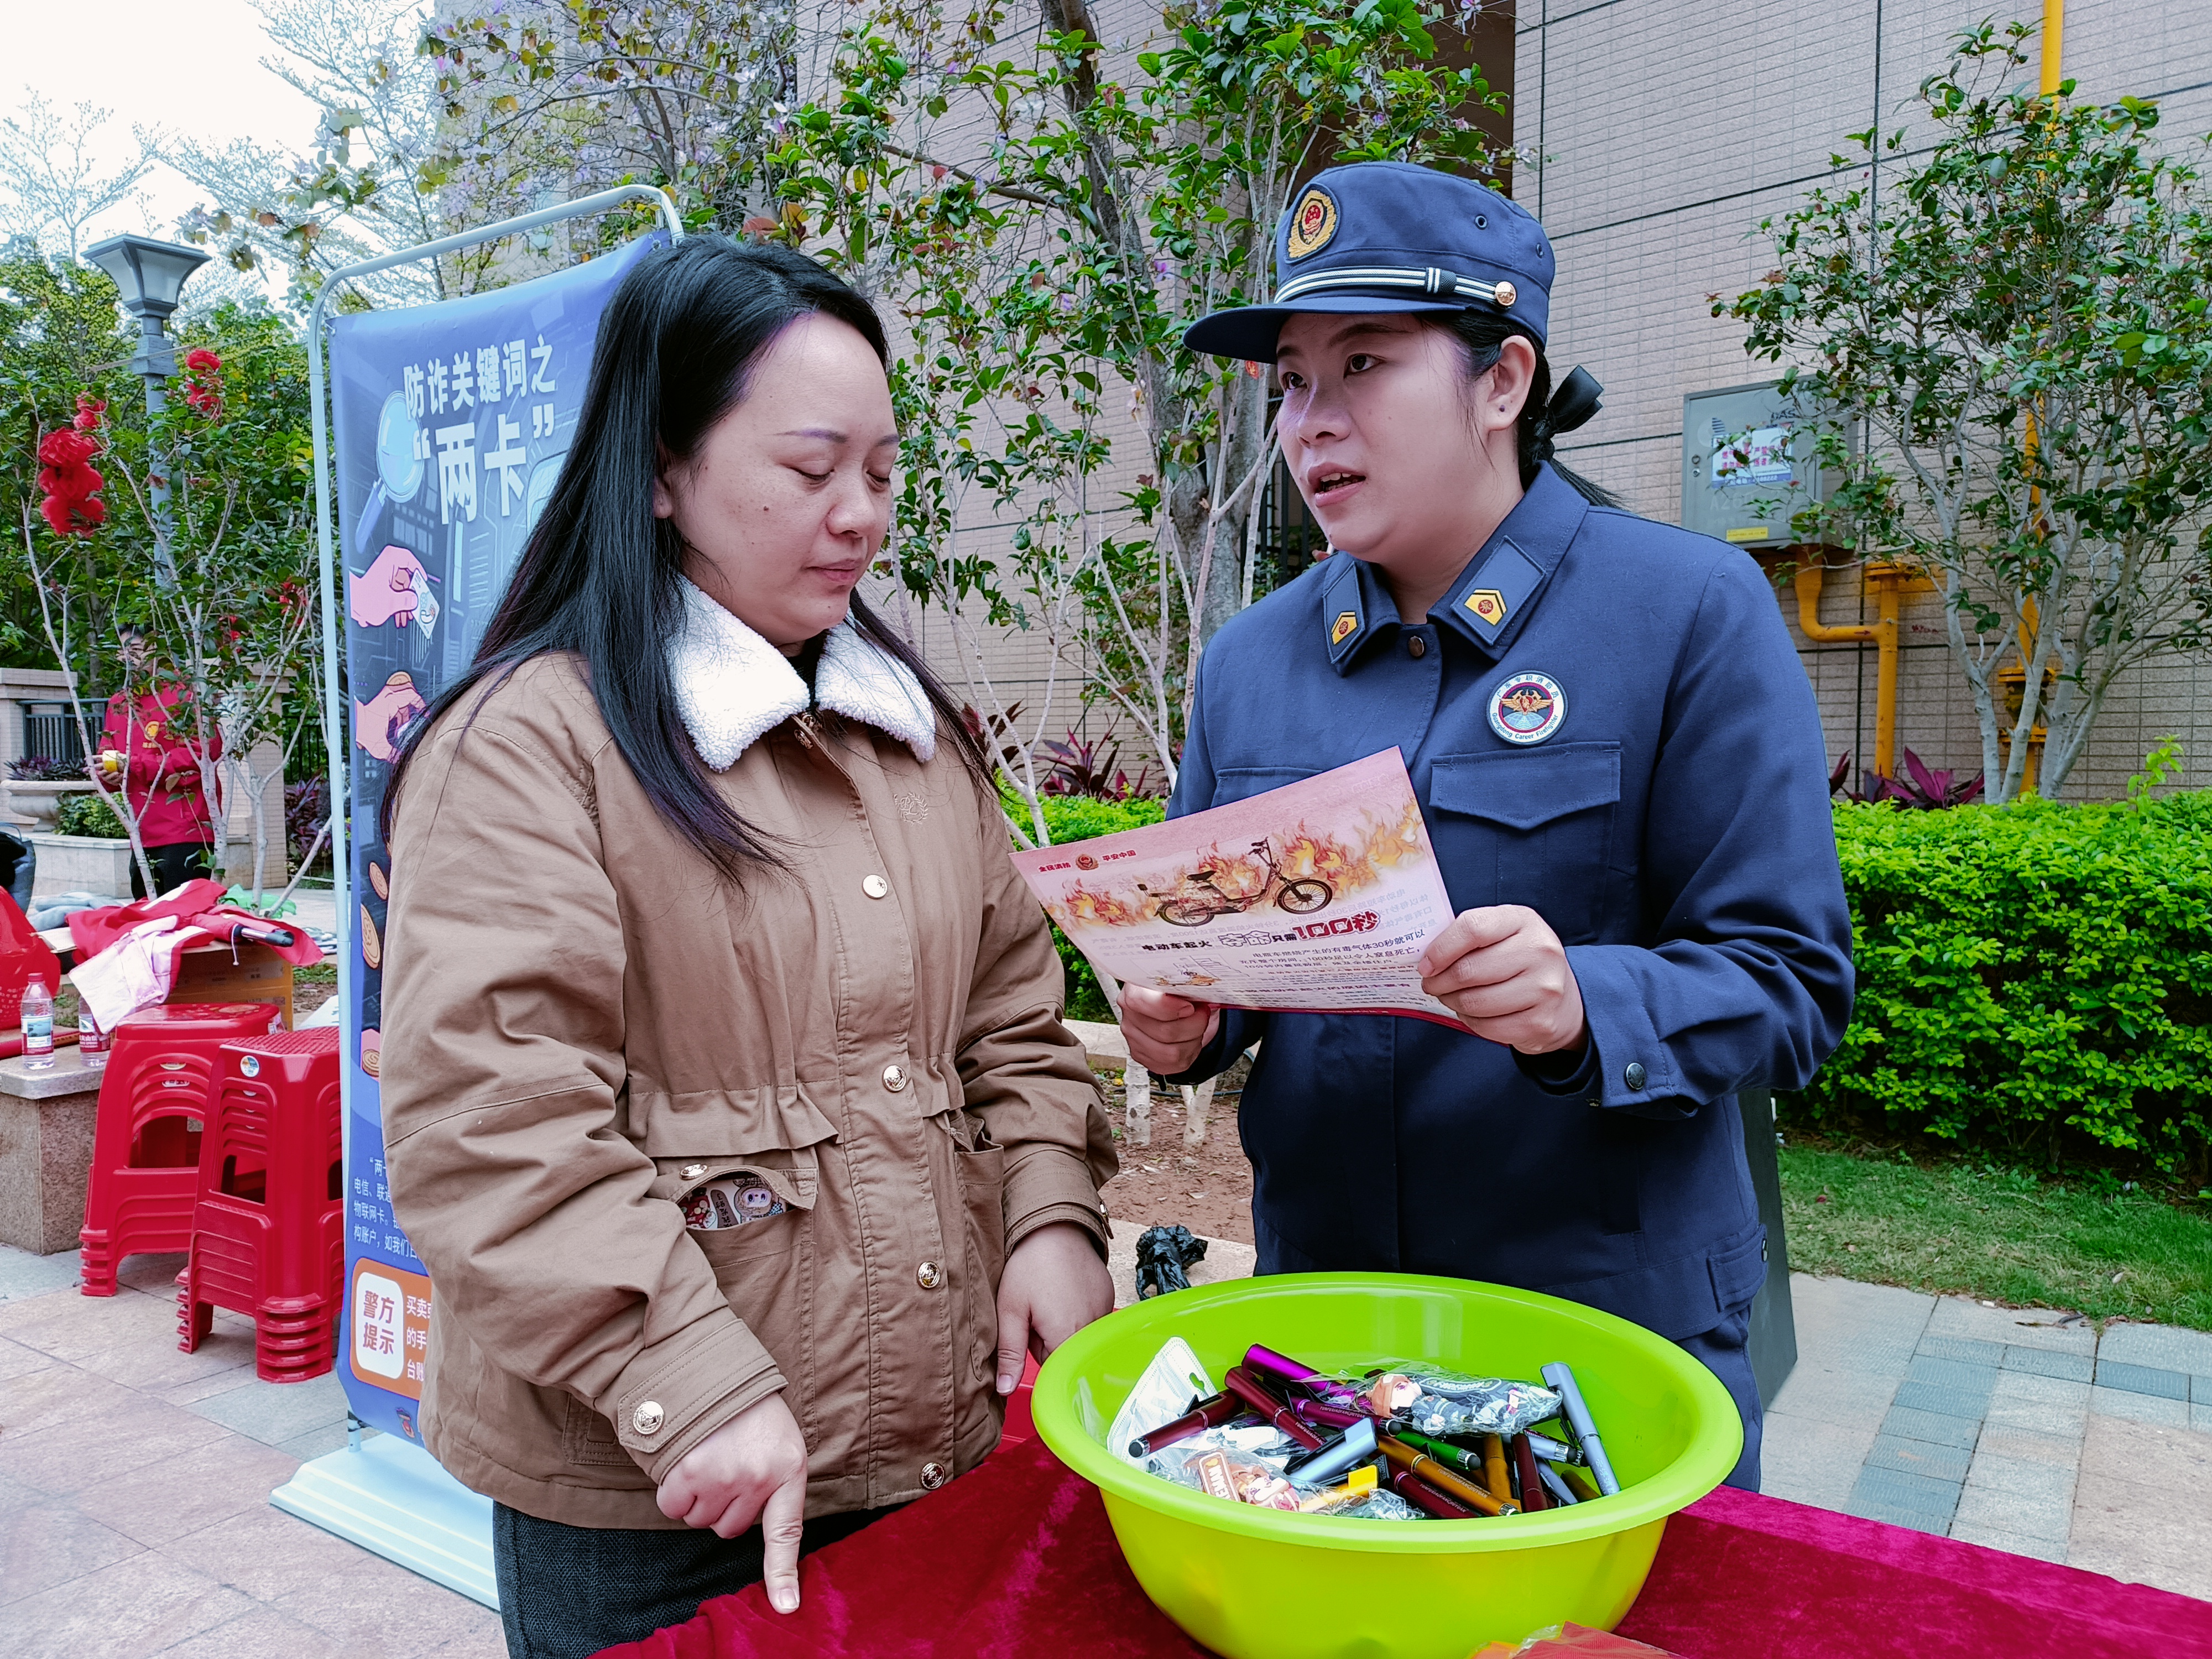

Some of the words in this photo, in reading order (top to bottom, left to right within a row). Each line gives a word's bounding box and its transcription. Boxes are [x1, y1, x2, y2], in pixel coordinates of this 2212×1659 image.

[403, 333, 556, 420] 防诈关键词之
[413, 403, 555, 525] “两卡”
[1496, 675, 1559, 701] 广东专职消防员
[1492, 712, 1513, 738] Guangdong
[1536, 714, 1559, 737] Firefighter
[1102, 849, 1137, 862] 平安中国
[1141, 940, 1213, 951] 电动车起火
[369, 1157, 387, 1177] “两
[363, 1290, 395, 1324] 警方
[362, 1322, 395, 1355] 提示
